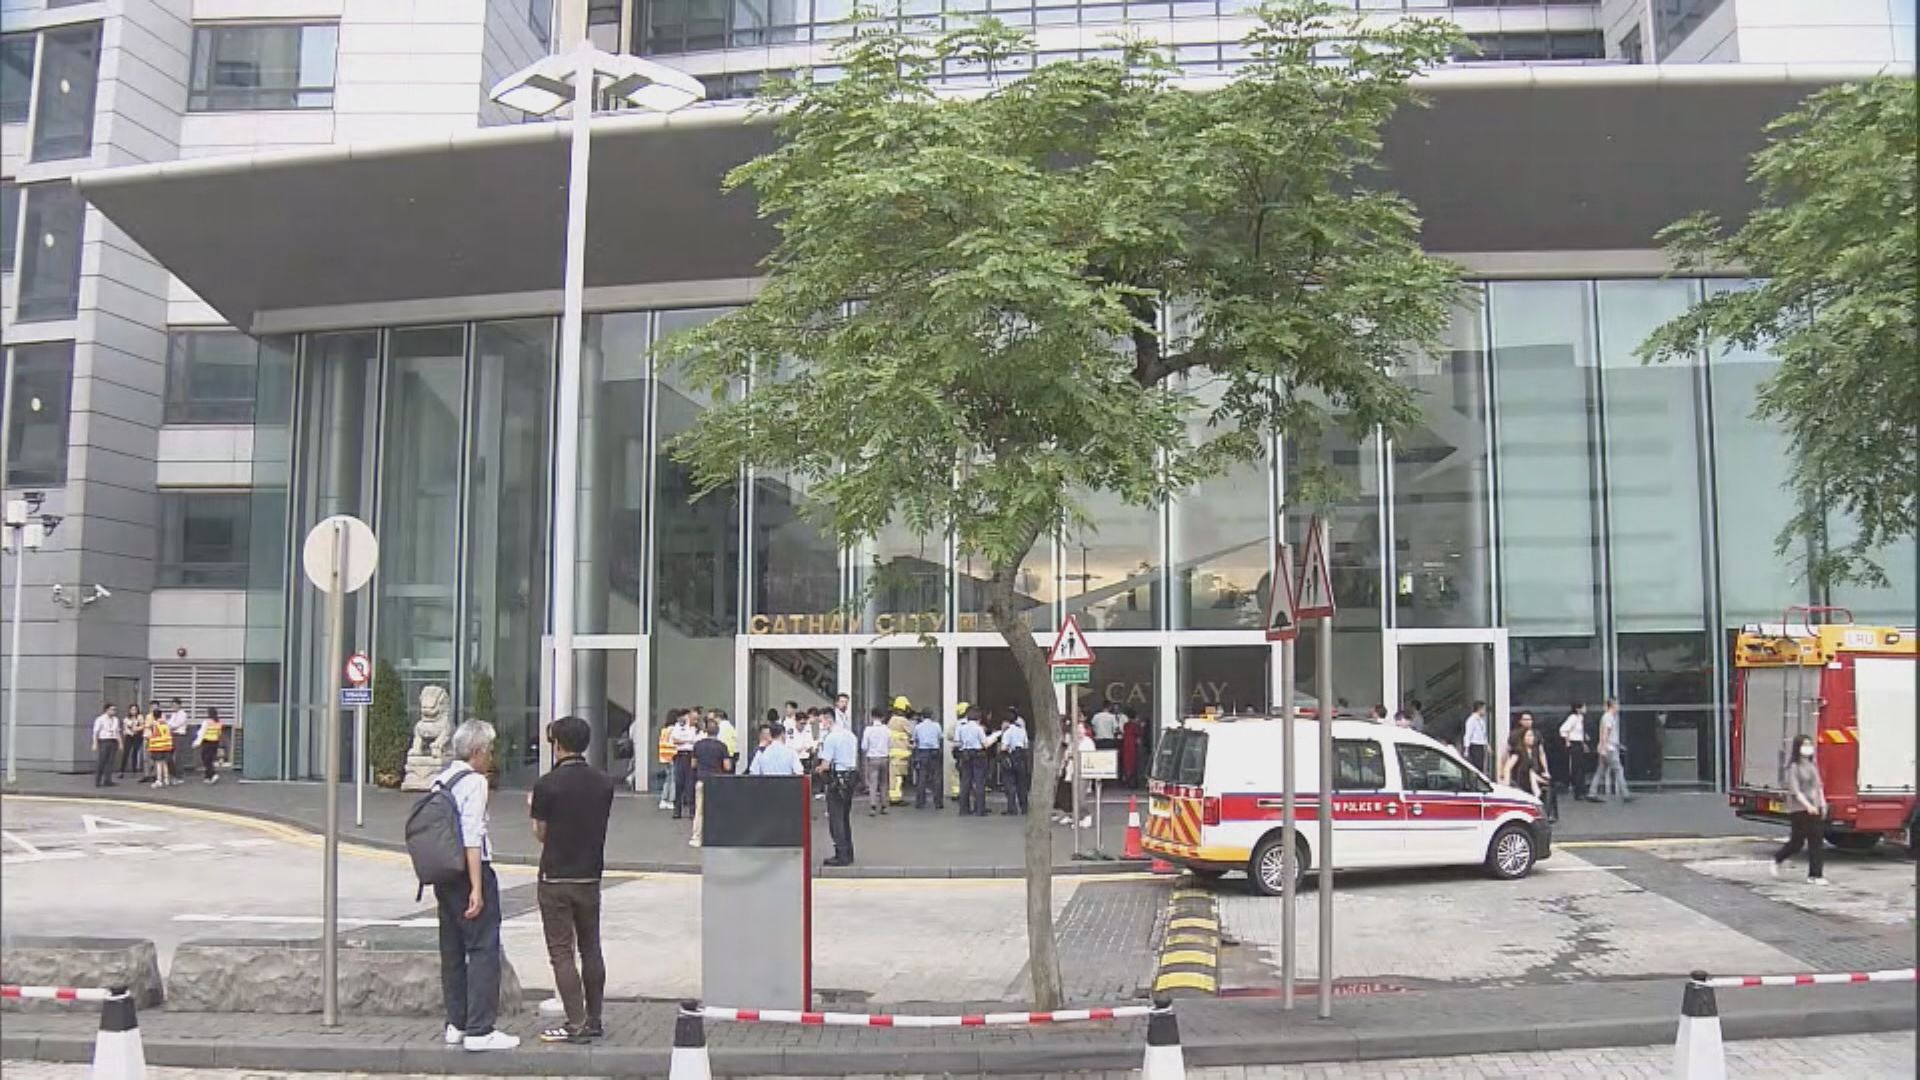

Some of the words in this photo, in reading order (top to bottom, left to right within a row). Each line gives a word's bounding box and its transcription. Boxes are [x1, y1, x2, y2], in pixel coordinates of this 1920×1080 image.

[875, 613, 944, 634] CITY
[1105, 682, 1228, 703] CAAY
[1343, 802, 1372, 811] POLICE
